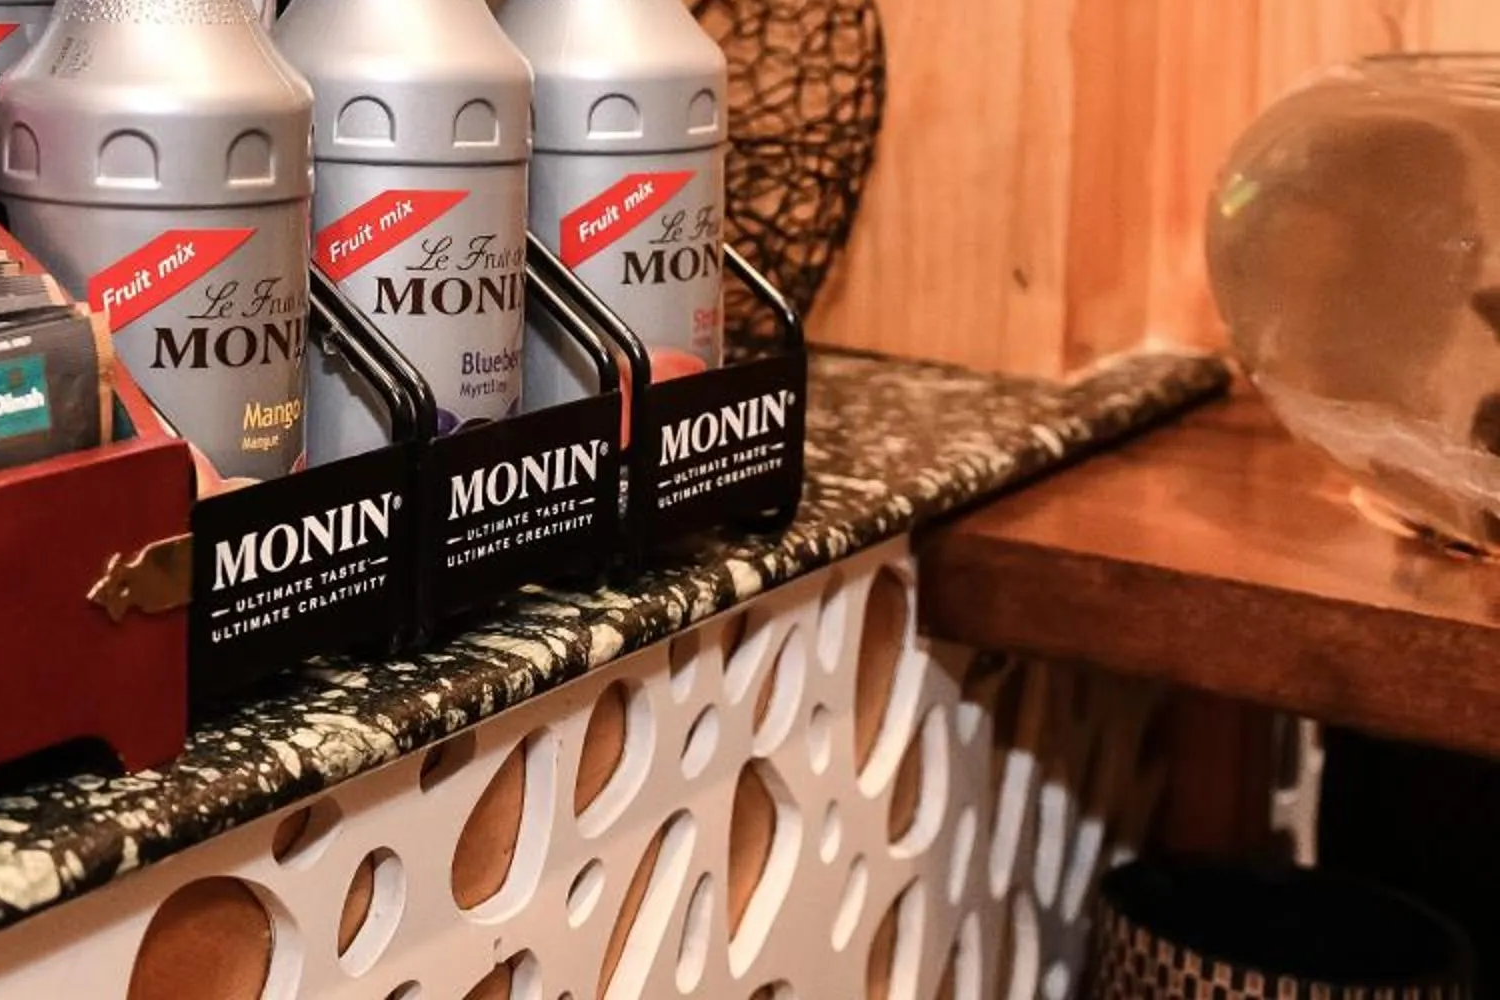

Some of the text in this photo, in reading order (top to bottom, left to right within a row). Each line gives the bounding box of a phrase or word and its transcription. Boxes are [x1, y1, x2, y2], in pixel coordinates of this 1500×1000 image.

[330, 200, 414, 262] Fruit mix
[578, 180, 655, 242] Fruit mix
[102, 242, 196, 309] Fruit mix
[621, 240, 721, 285] MON
[461, 348, 519, 376] Blueb
[243, 399, 301, 430] Mango
[446, 513, 594, 568] ULTIMATE CREATIVITY
[467, 499, 576, 541] ULTIMATE TASTE
[212, 574, 386, 643] ULTIMATE CREATIVITY
[235, 559, 367, 612] ULTIMATE TASTE
